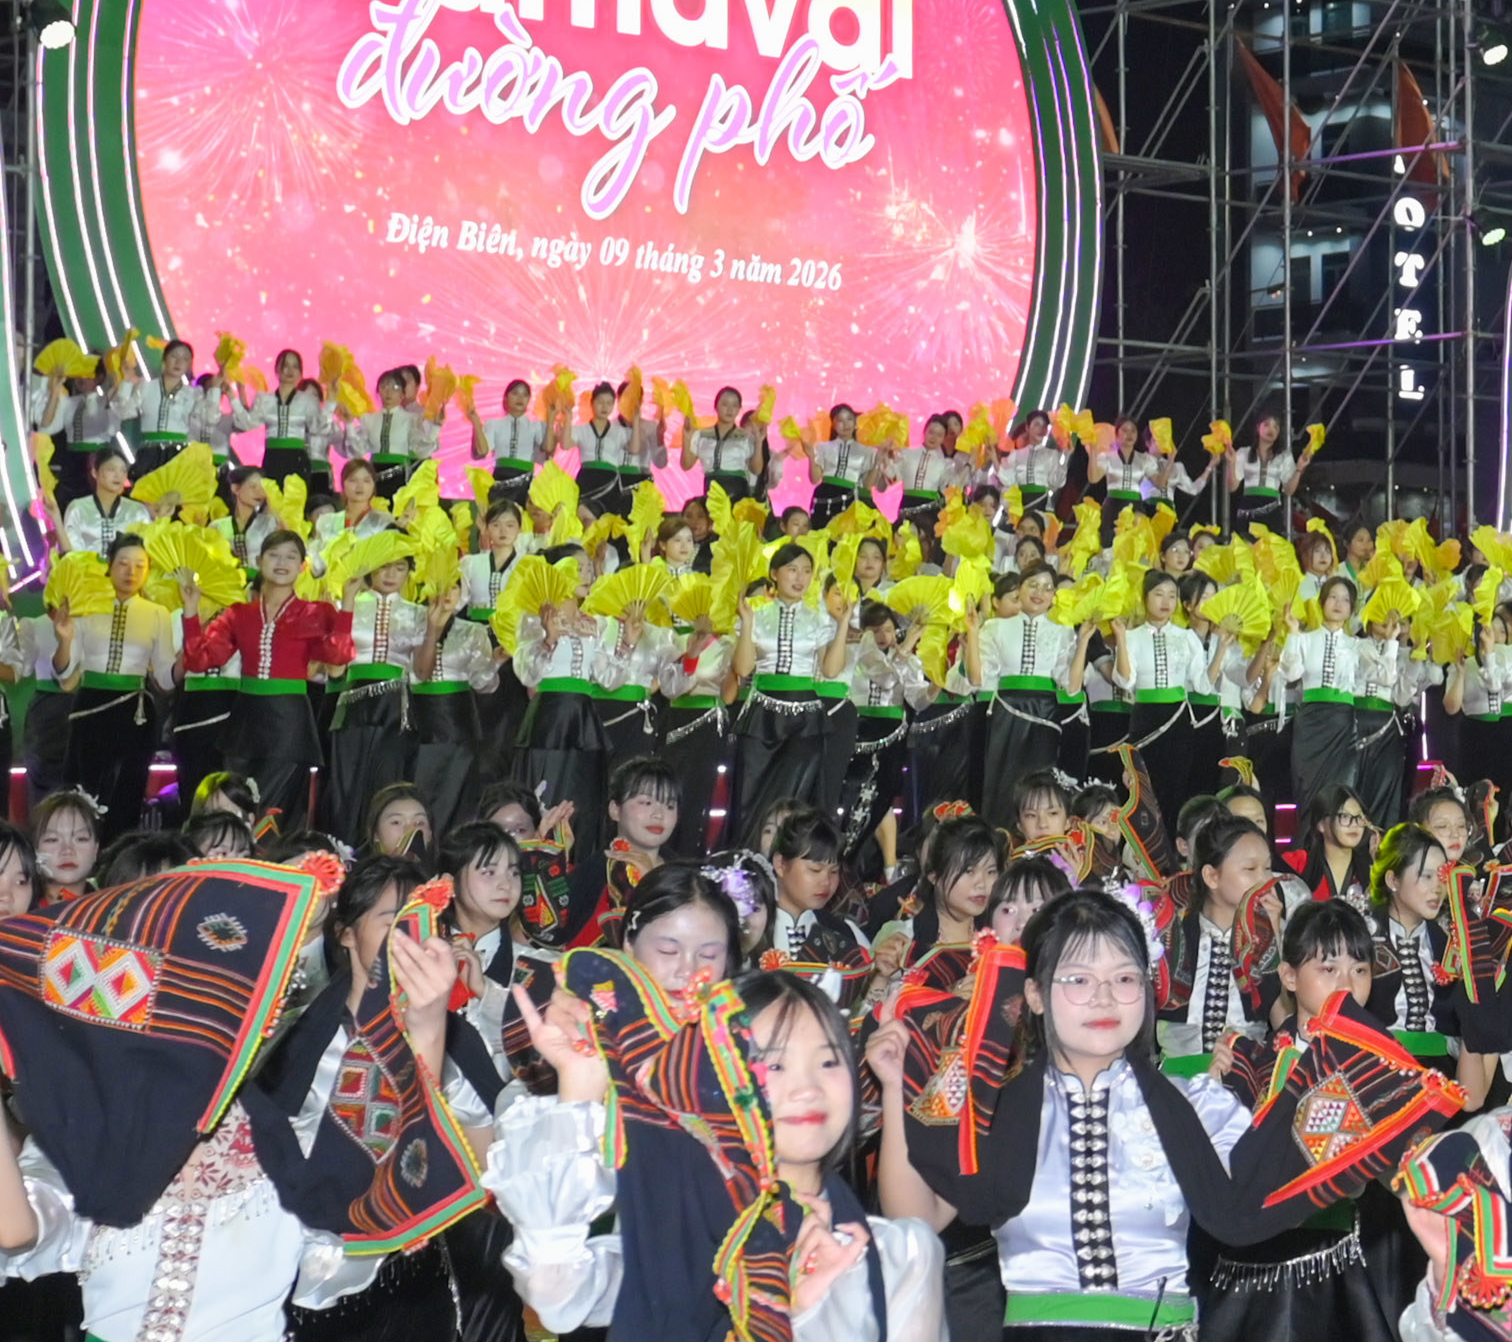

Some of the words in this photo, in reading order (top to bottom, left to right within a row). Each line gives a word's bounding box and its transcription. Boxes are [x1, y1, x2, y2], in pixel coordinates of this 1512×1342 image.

[673, 38, 899, 214] phố
[386, 212, 449, 254] Điện
[456, 220, 524, 262] Biên,
[531, 231, 592, 271] ngày
[599, 236, 630, 267] 09
[634, 240, 705, 284] tháng
[709, 248, 726, 278] 3
[730, 253, 783, 285] năm
[787, 257, 843, 291] 2026
[1393, 149, 1425, 400] OTEL
